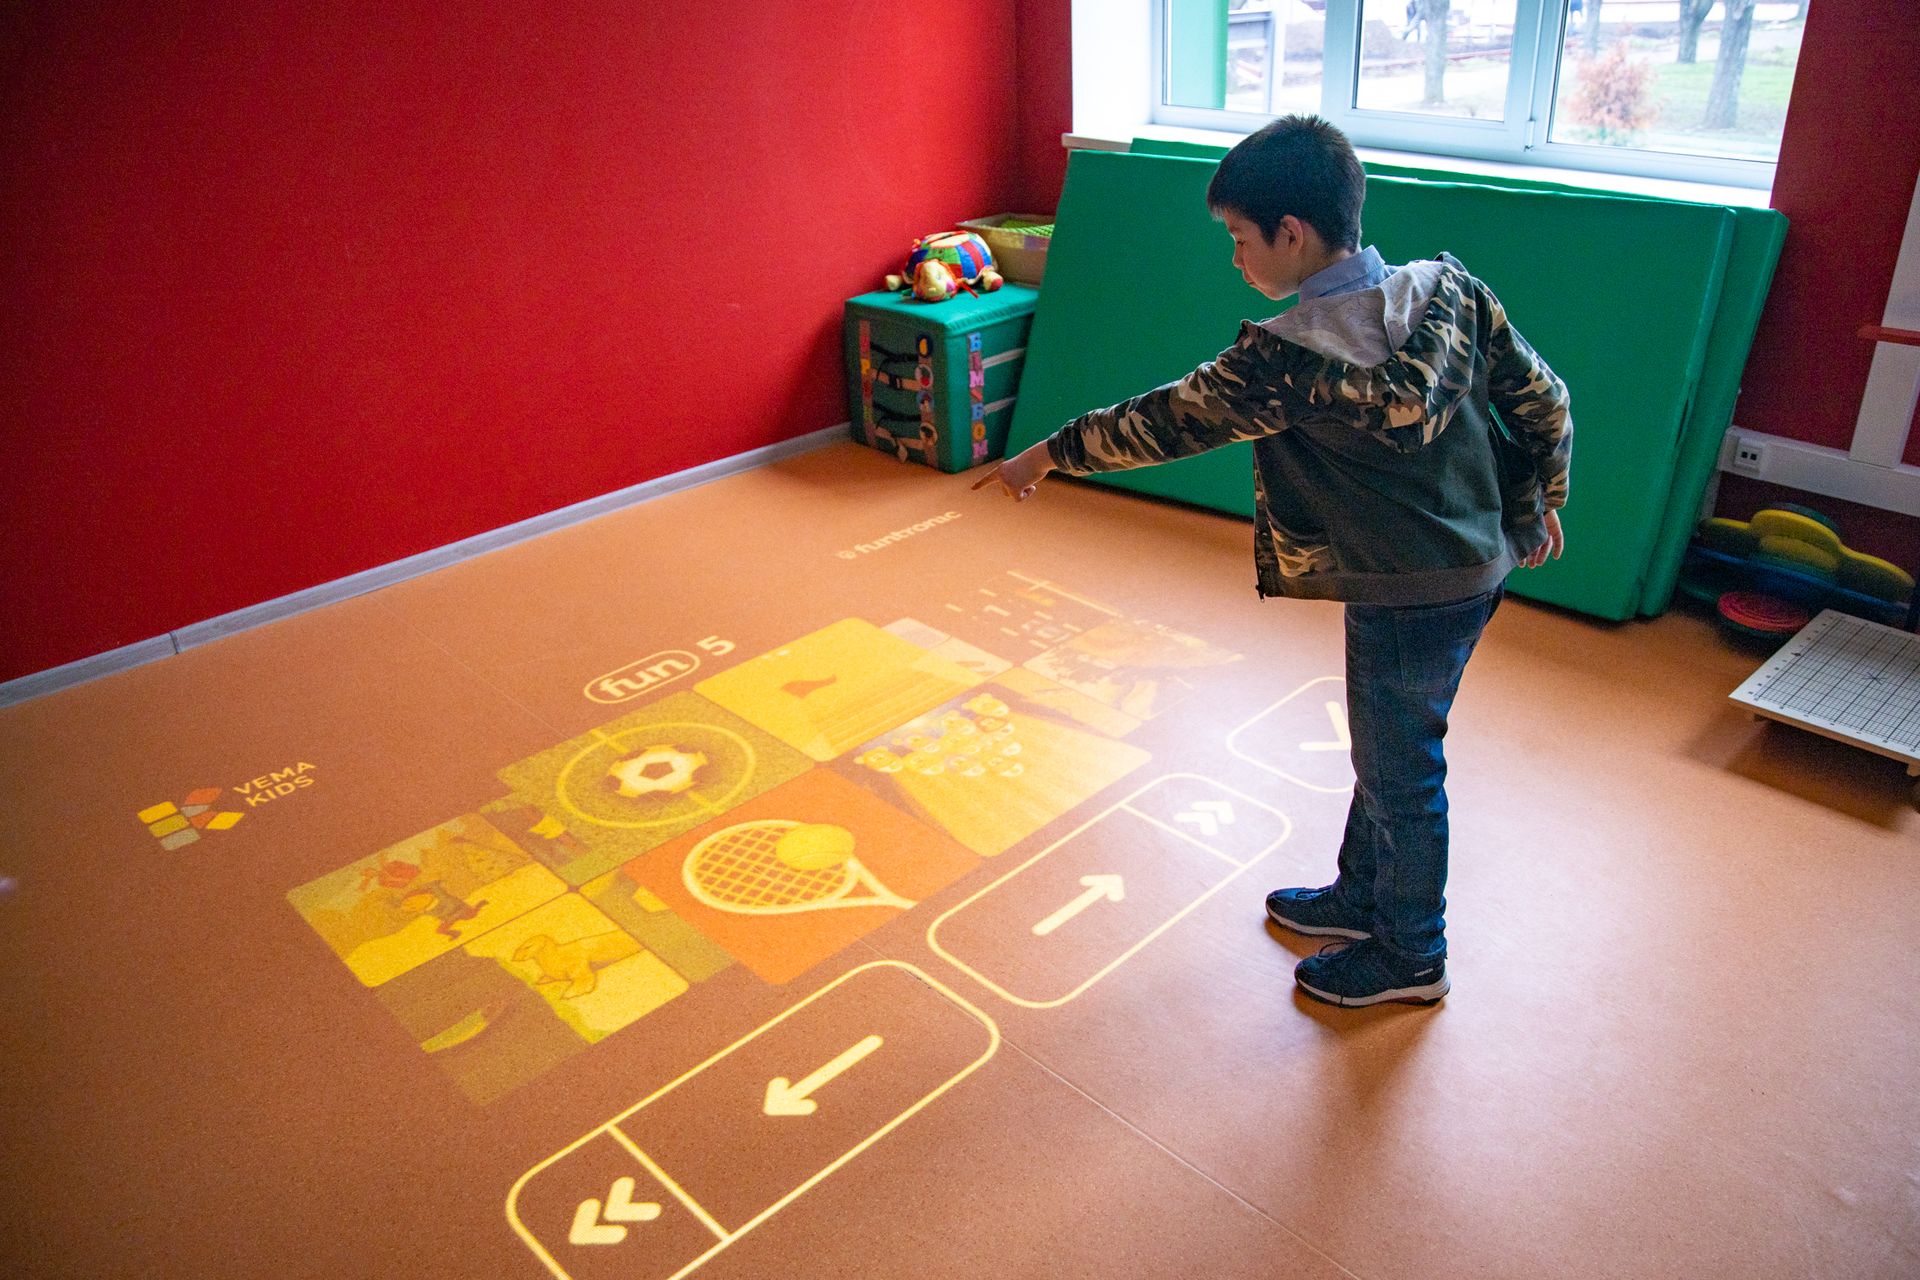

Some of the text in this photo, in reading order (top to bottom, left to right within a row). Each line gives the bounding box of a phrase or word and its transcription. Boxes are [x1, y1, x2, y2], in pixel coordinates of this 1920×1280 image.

[600, 635, 736, 698] fun 5
[233, 761, 317, 794] VEMA
[245, 775, 315, 807] KIDS
